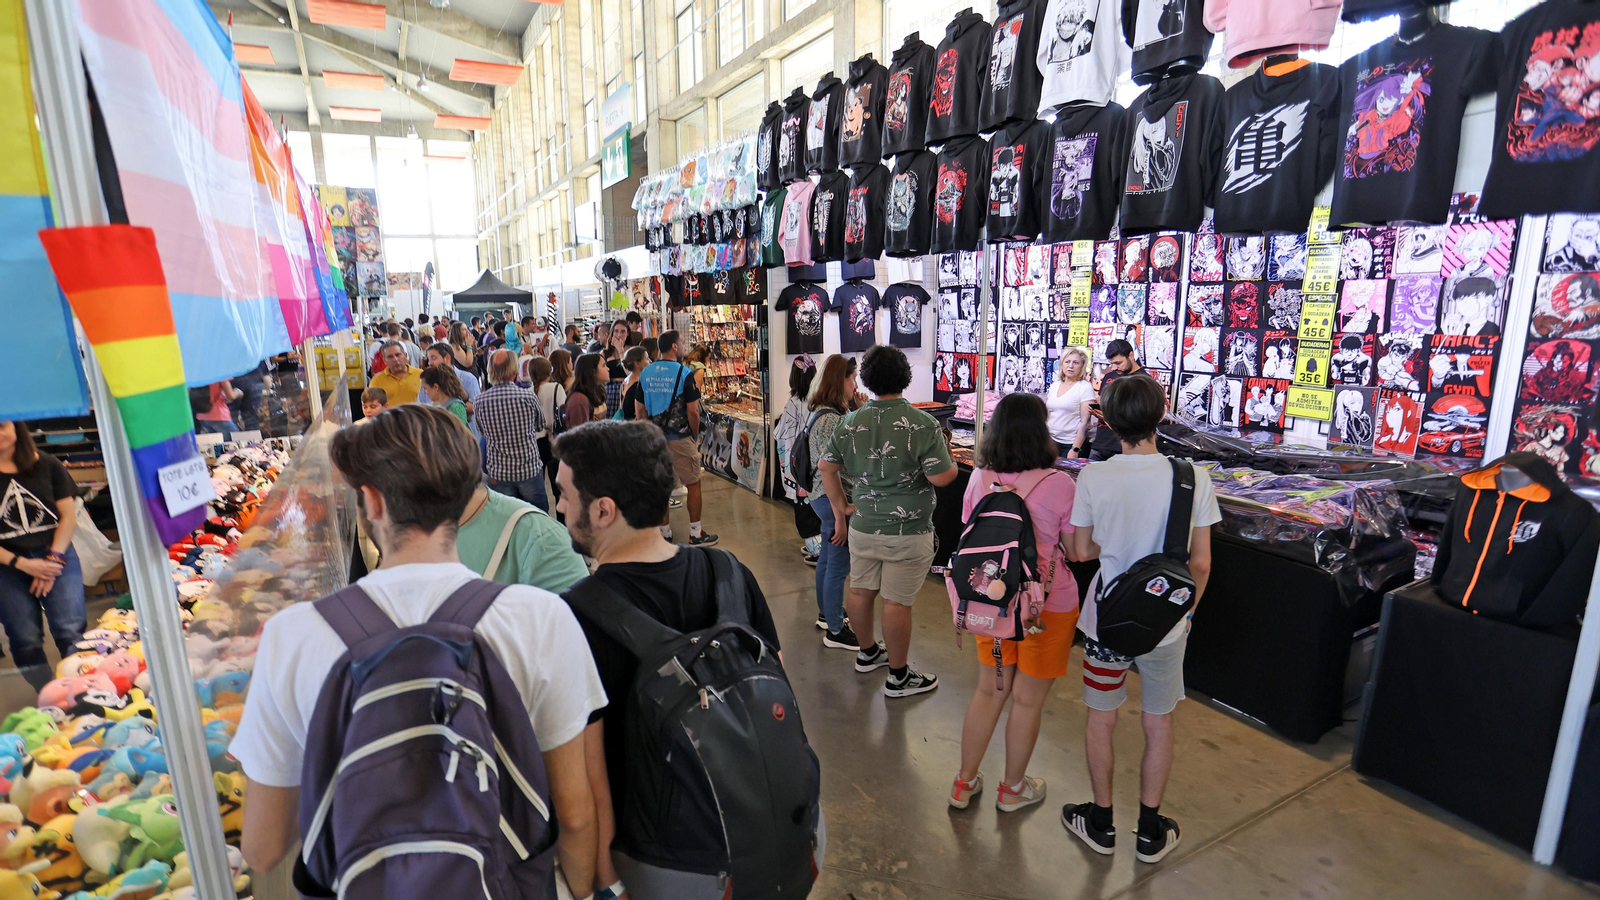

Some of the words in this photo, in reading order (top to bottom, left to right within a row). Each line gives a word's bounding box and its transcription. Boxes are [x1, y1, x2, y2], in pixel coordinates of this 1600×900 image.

[1313, 230, 1336, 241] 35€
[1308, 281, 1331, 292] 45€
[1073, 297, 1087, 305] 25€
[1303, 327, 1326, 337] 45€
[1071, 336, 1084, 344] 35€
[1299, 372, 1321, 384] 35€
[1296, 397, 1322, 405] ADMITEN
[1406, 391, 1427, 402] TWO
[1288, 401, 1329, 412] DEVOLUCIONES
[177, 482, 200, 502] 10€
